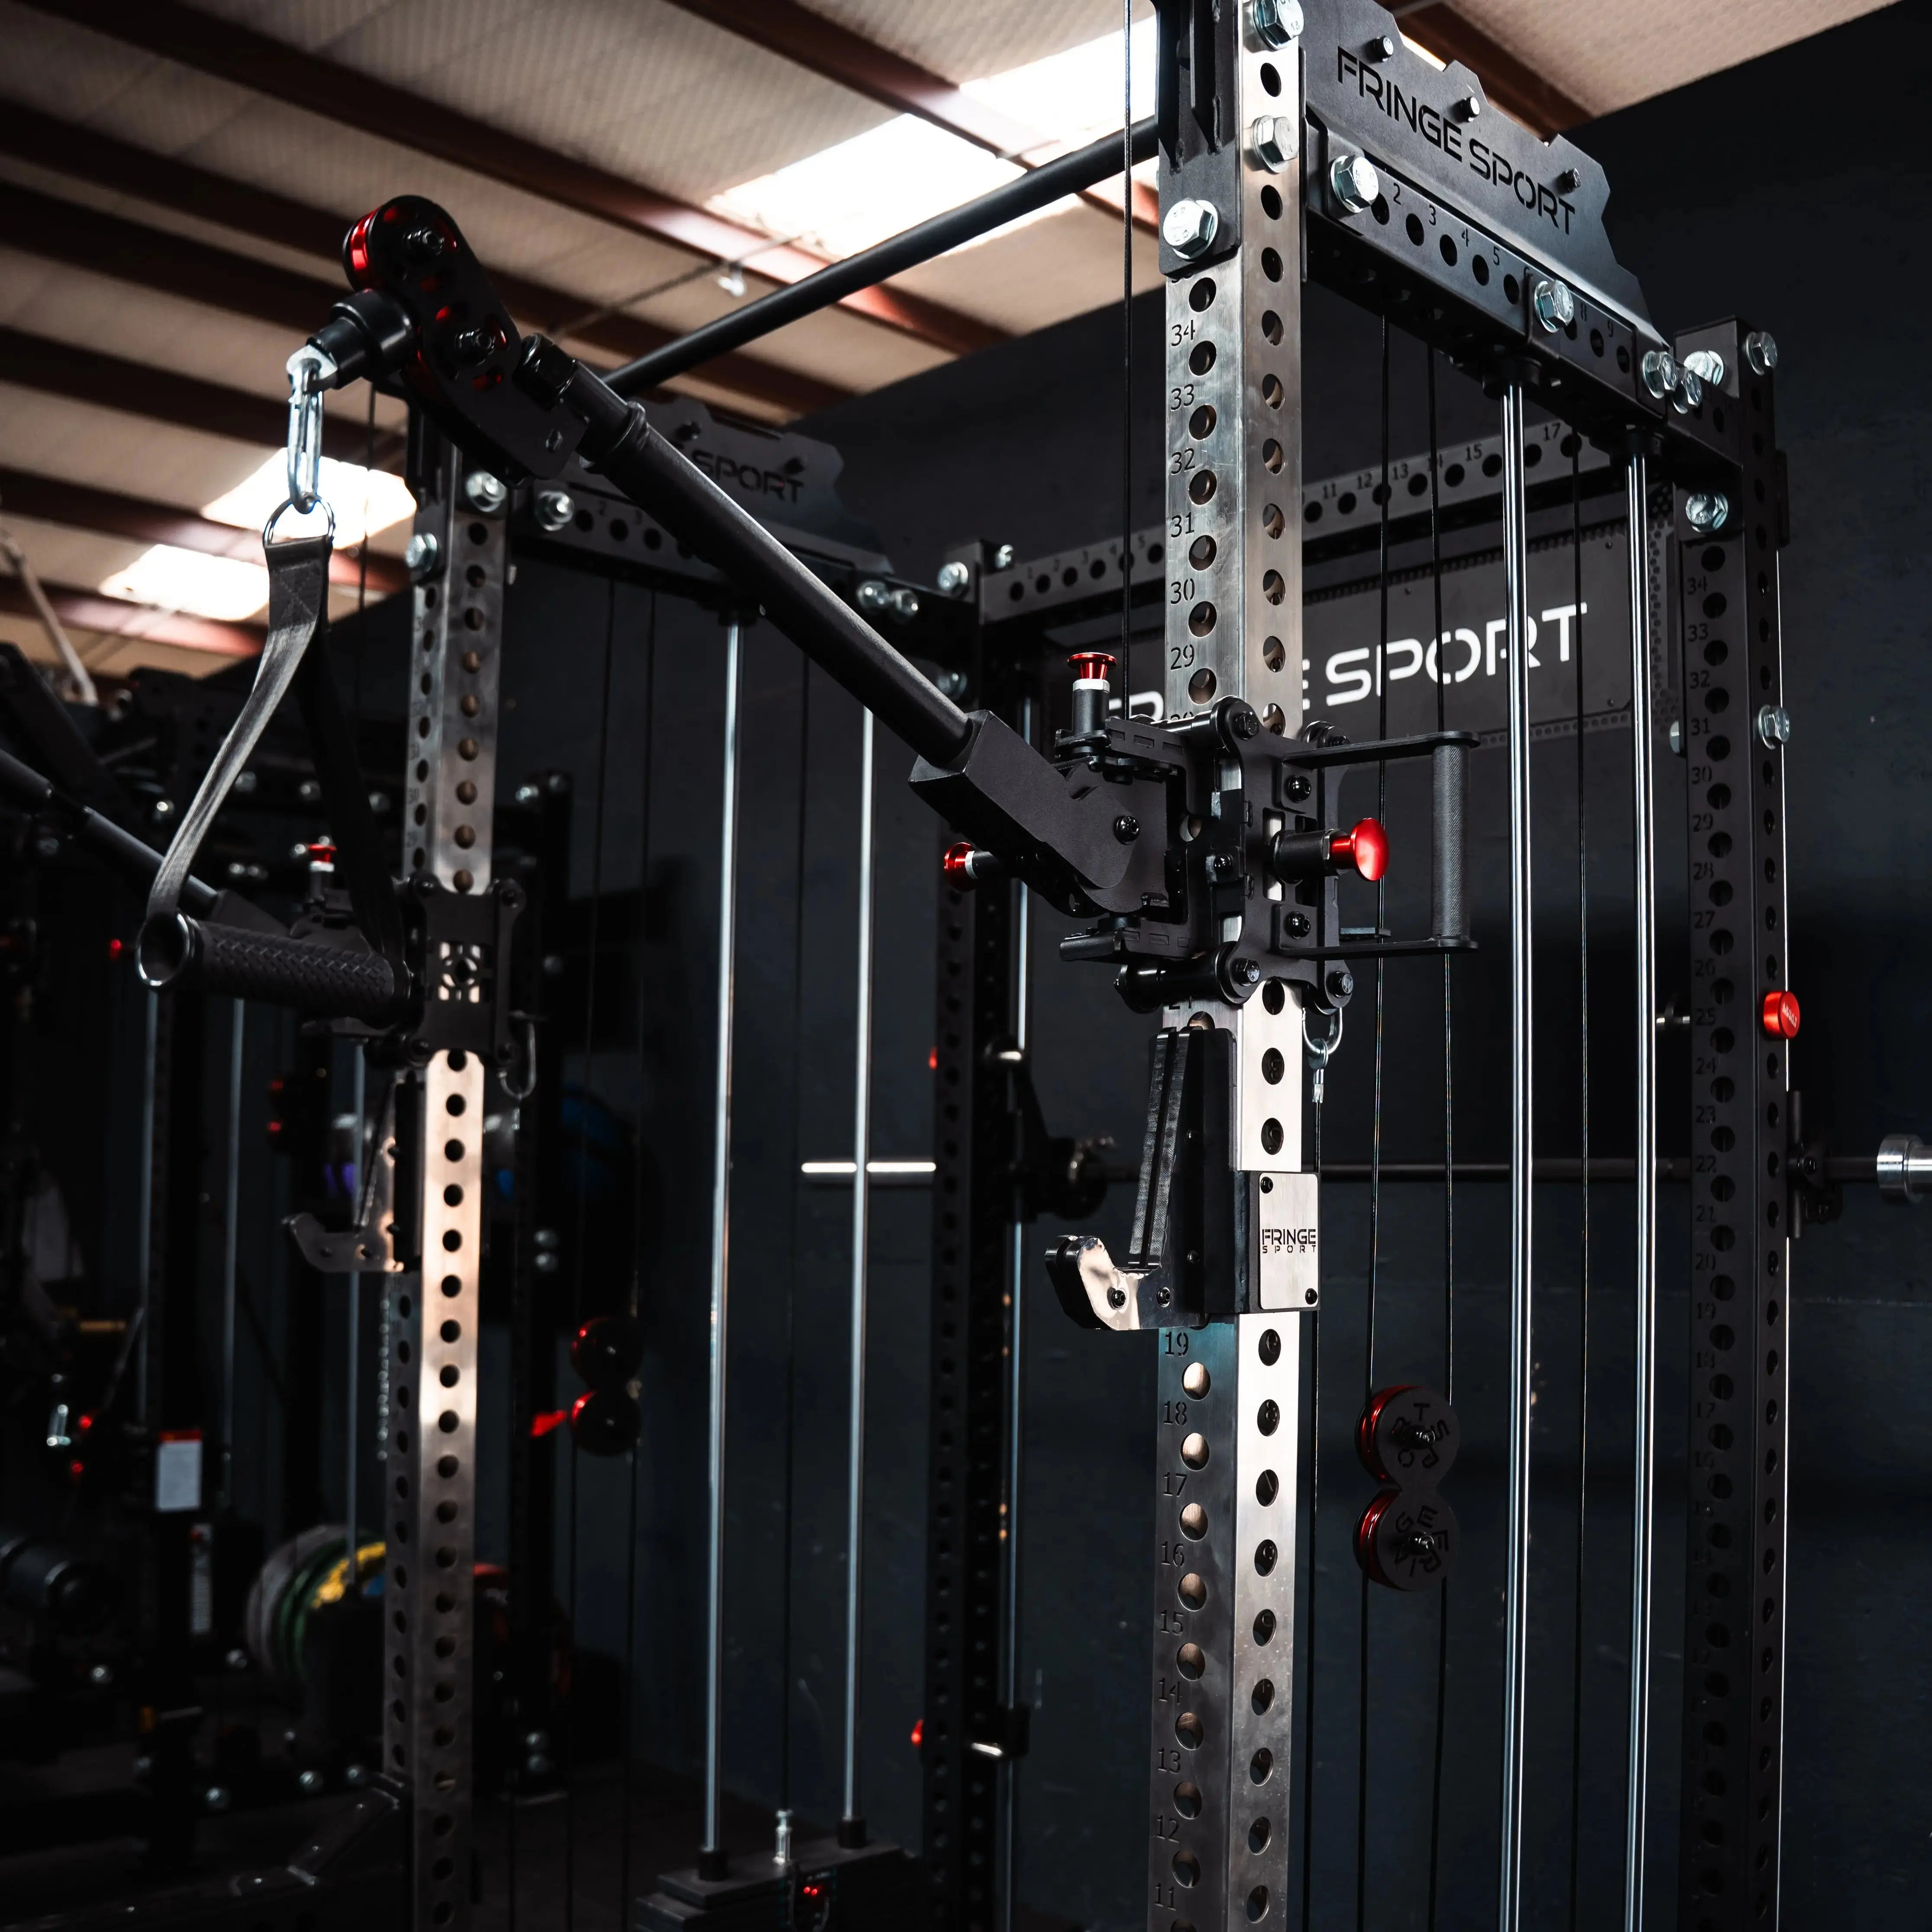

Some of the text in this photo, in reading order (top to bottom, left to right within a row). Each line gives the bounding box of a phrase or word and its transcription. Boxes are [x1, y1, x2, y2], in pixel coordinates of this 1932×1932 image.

[1338, 45, 1575, 235] FRINGE SPORT
[1393, 183, 1401, 205] 2
[1429, 204, 1436, 226] 3
[1461, 228, 1470, 247] 4
[1494, 248, 1500, 266] 5
[1171, 319, 1195, 347] 34
[1171, 383, 1195, 411] 33
[1171, 448, 1195, 475] 32
[1323, 483, 1337, 499] 11
[1357, 473, 1373, 489] 12
[1393, 464, 1409, 480] 13
[1465, 444, 1482, 461] 15
[1543, 423, 1561, 441] 17
[692, 450, 804, 503] SPORT
[1171, 512, 1195, 538] 31
[1171, 578, 1195, 604] 30
[1687, 576, 1707, 595] 34
[1688, 623, 1708, 642] 33
[1170, 644, 1195, 670] 29
[1325, 602, 1587, 706] SPORT
[1690, 670, 1710, 689] 32
[1690, 717, 1711, 736] 31
[1691, 765, 1713, 785] 30
[1692, 812, 1714, 832] 29
[1693, 862, 1714, 880] 28
[1694, 910, 1716, 929] 27
[1262, 1229, 1316, 1245] FRINGE
[1262, 1245, 1316, 1254] SPORT
[1165, 1331, 1189, 1356] 19
[1164, 1401, 1188, 1426] 18
[1163, 1472, 1188, 1497] 17
[1161, 1541, 1185, 1568] 16
[1160, 1609, 1184, 1636] 15
[1158, 1678, 1182, 1705] 14
[1157, 1747, 1181, 1774] 13
[1156, 1815, 1180, 1843] 12
[1154, 1883, 1177, 1911] 11
